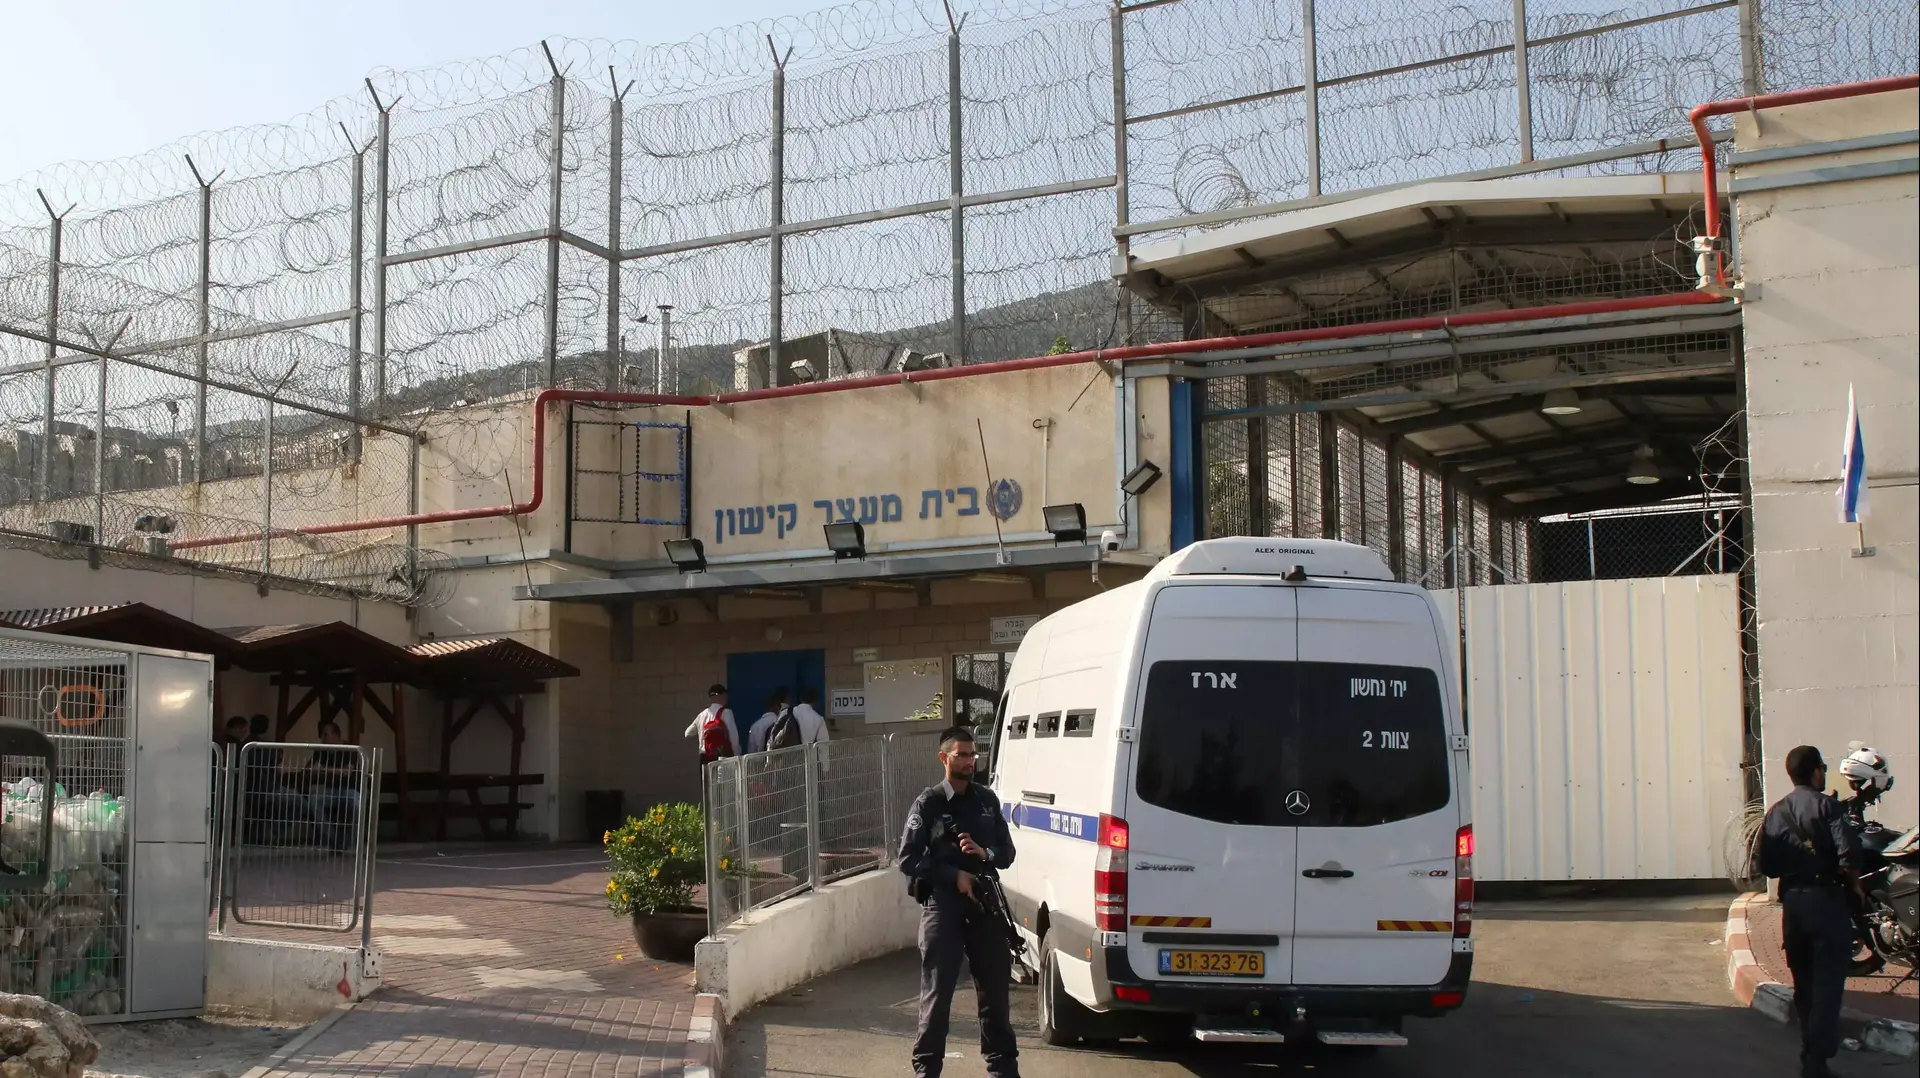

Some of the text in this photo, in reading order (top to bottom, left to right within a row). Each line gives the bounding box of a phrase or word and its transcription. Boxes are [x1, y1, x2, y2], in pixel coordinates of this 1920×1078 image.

[715, 486, 980, 544] בית מעצר קישון
[1004, 620, 1025, 629] קבלה
[1191, 671, 1237, 689] ארז
[1350, 677, 1386, 699] נחשון
[834, 696, 865, 708] כניסה
[1362, 730, 1410, 750] צוות 2
